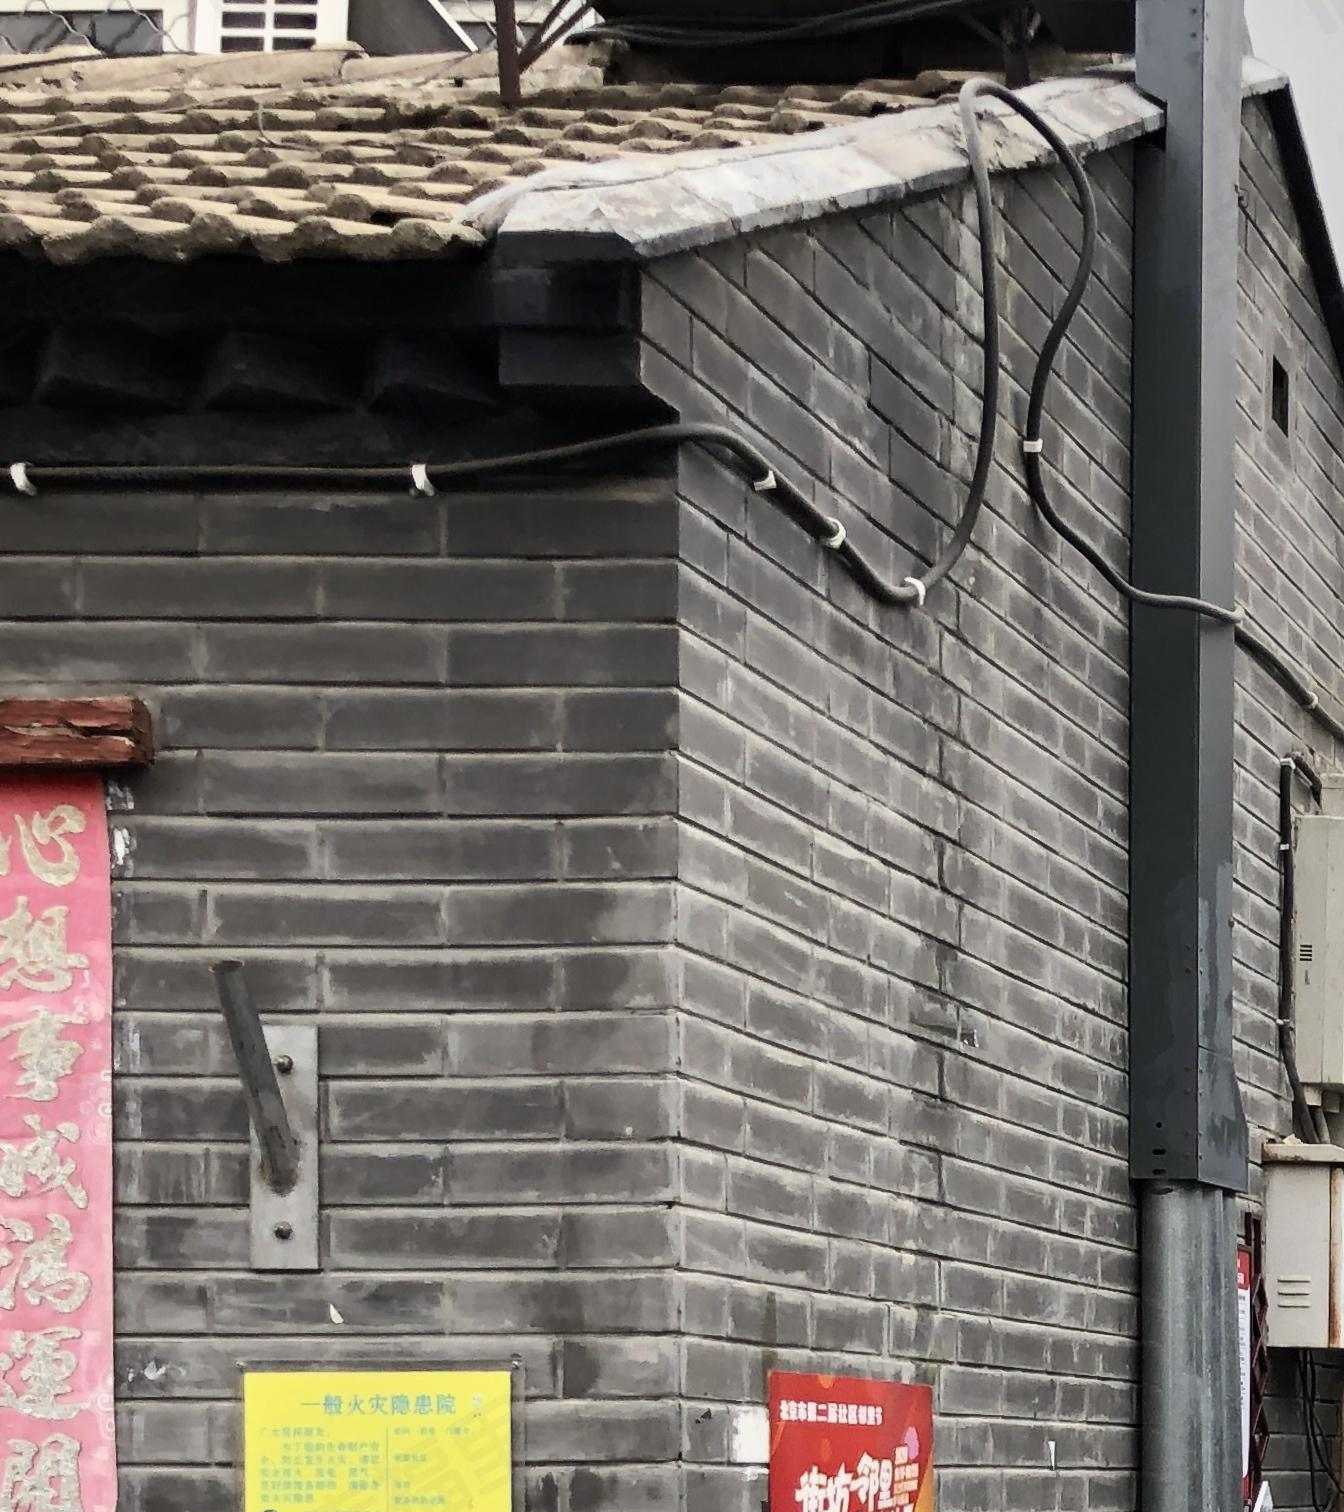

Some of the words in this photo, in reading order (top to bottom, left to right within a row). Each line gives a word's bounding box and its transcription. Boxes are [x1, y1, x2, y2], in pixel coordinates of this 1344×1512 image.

[300, 1394, 457, 1415] 一般火灾隐患院
